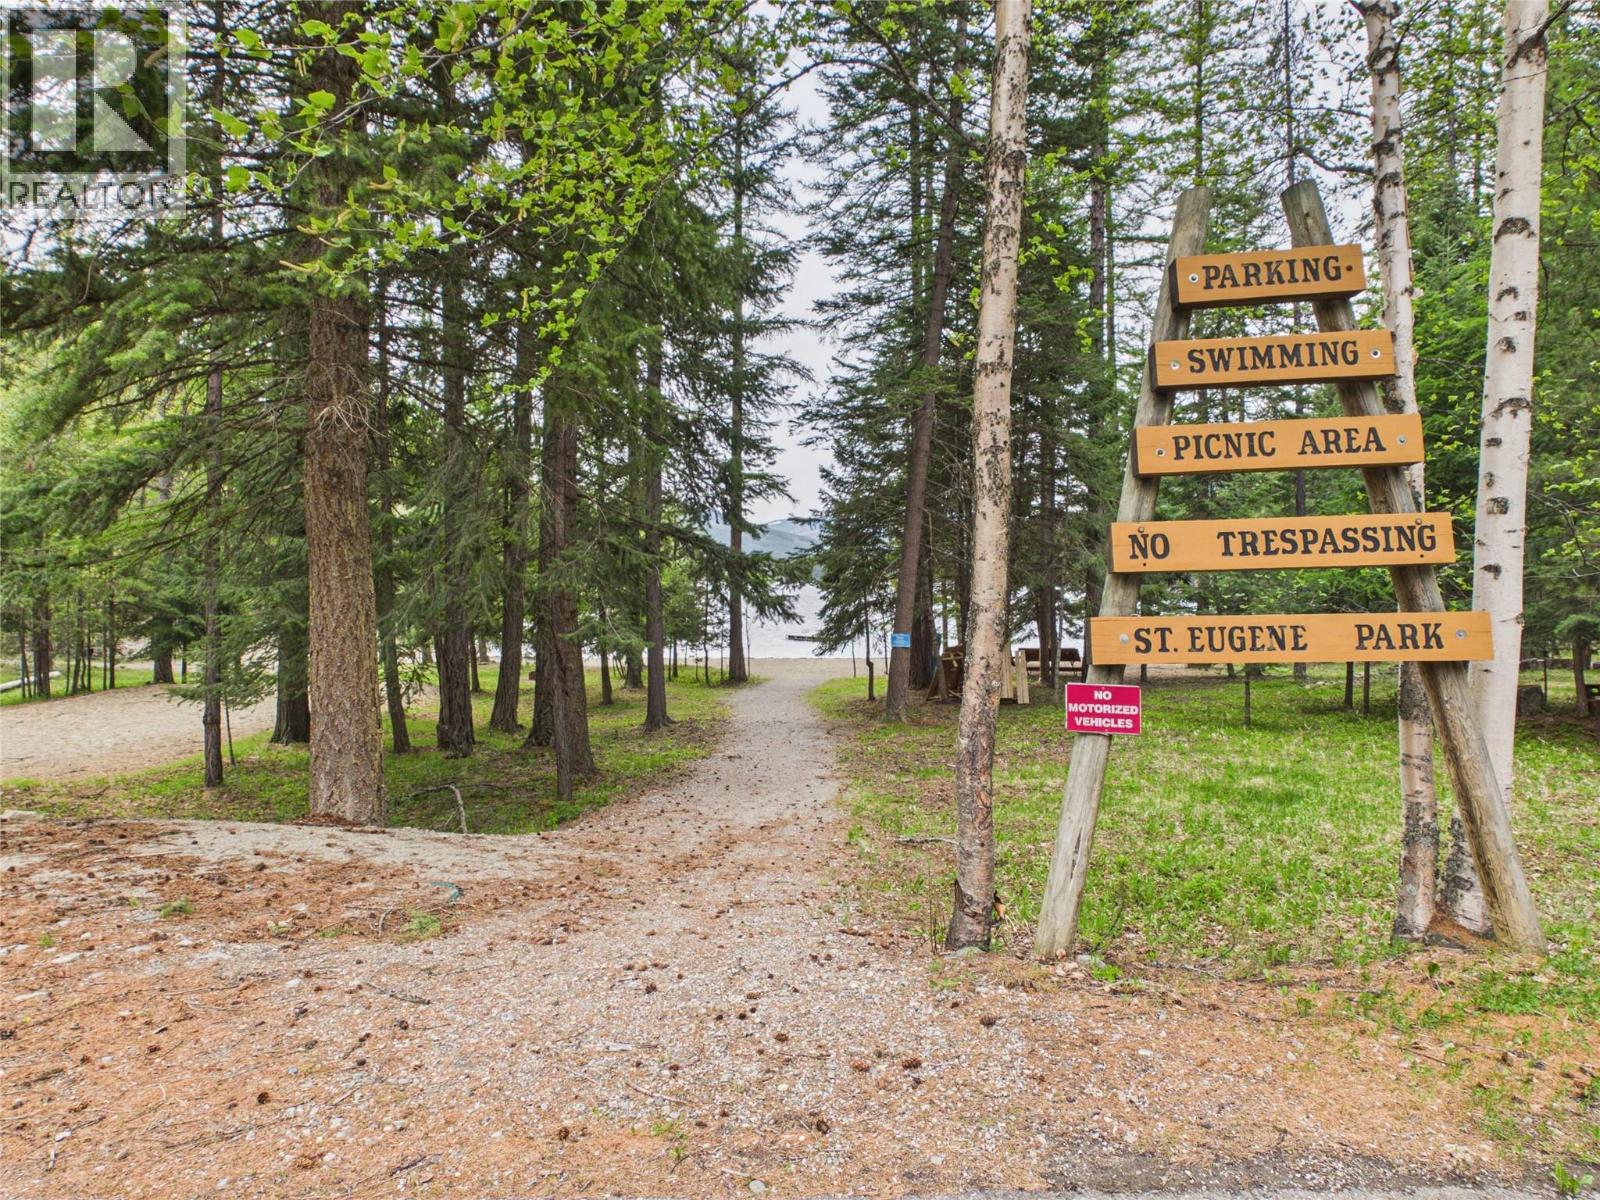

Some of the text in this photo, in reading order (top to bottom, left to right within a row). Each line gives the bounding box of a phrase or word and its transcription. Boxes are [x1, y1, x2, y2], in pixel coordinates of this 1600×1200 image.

[1202, 255, 1342, 290] PARKING
[1187, 340, 1359, 374] SWIMMING
[1173, 427, 1386, 460] PICNIC AREA
[1128, 524, 1437, 560] NO TRESPASSING
[1134, 623, 1444, 654] ST. EUGENE PARK
[1068, 702, 1139, 715] MOTORIZED
[1094, 690, 1112, 700] NO
[1074, 716, 1133, 728] VEHICLES
